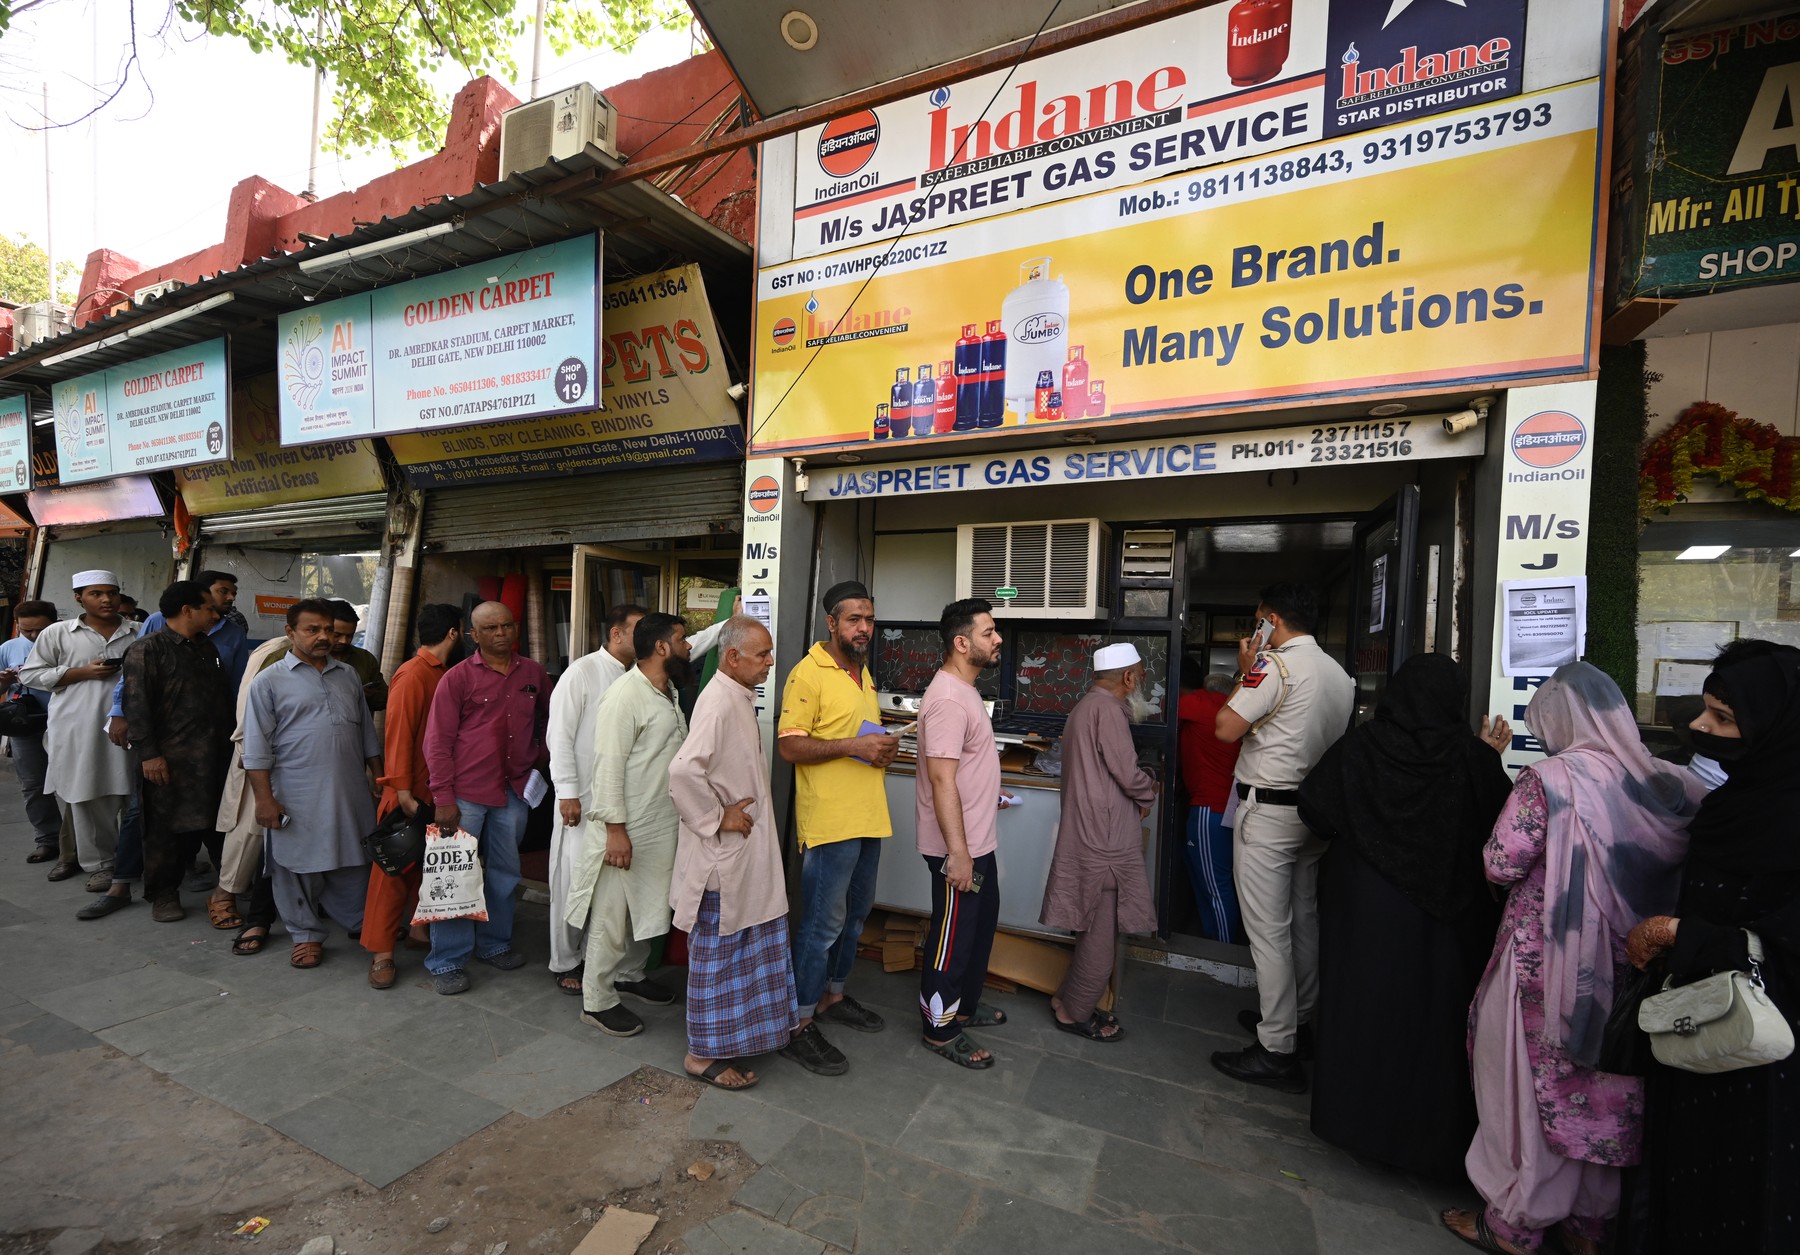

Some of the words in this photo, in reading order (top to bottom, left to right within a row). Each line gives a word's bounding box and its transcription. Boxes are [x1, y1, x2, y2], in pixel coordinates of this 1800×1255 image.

[1231, 20, 1289, 48] Indane
[1663, 27, 1737, 65] GST
[1339, 36, 1512, 99] Indane
[1340, 62, 1502, 108] SAFE.RELIABLE.CONVENIENT
[1337, 107, 1381, 127] STAR
[1385, 77, 1508, 117] DISTRIBUTOR
[925, 66, 1187, 173] Indane
[820, 127, 877, 156] इंडियनऑयल
[925, 112, 1171, 186] SAFE.RELIABLE.CONVENIENT
[1118, 190, 1180, 217] Mob.:
[1187, 149, 1354, 203] 9811138843,
[1362, 102, 1553, 166] 9319753793
[815, 171, 880, 201] IndianOil
[819, 215, 863, 246] M/s
[871, 171, 1032, 233] JASPREET
[1043, 150, 1116, 192] GAS
[1128, 102, 1309, 171] SERVICE
[1649, 194, 1713, 236] Mfr:
[1721, 184, 1766, 224] All
[1124, 263, 1214, 305] One
[1230, 221, 1401, 288] Brand.
[1698, 242, 1798, 281] SHOP
[771, 274, 795, 291] GST
[797, 269, 815, 285] NO
[403, 291, 475, 327] GOLDEN
[479, 271, 556, 311] CARPET
[331, 321, 352, 353] AI
[388, 348, 402, 360] DR.
[403, 339, 449, 357] AMBEDKAR
[450, 330, 493, 349] STADIUM,
[494, 323, 531, 340] CARPET
[532, 313, 577, 331] MARKET,
[807, 306, 912, 340] Indane
[1121, 323, 1244, 368] Many
[1259, 282, 1544, 349] Solutions.
[331, 350, 365, 368] IMPACT
[411, 353, 437, 369] DELHI
[437, 350, 463, 366] GATE,
[464, 346, 485, 360] NEW
[486, 339, 516, 356] DELHI
[517, 334, 547, 351] 110002
[771, 345, 797, 355] IndianOil
[123, 372, 163, 398] GOLDEN
[164, 362, 205, 389] CARPET
[331, 364, 368, 382] SUMMIT
[560, 363, 582, 374] SHOP
[565, 373, 577, 382] NO
[406, 388, 432, 401] Phone
[433, 385, 448, 397] No.
[449, 377, 500, 395] 9650411306,
[500, 367, 553, 387] 9818333417
[562, 383, 582, 400] 19
[84, 392, 97, 416] AI
[124, 406, 150, 420] AMBEDKAR
[173, 397, 193, 410] CARPET
[612, 388, 671, 410] VINYLS
[84, 413, 104, 427] IMPACT
[129, 417, 144, 428] DELHI
[144, 415, 158, 426] GATE,
[158, 413, 169, 423] NEW
[169, 409, 185, 421] DELHI
[419, 407, 437, 420] GST
[85, 423, 106, 437] SUMMIT
[441, 436, 489, 454] BLINDS,
[489, 433, 515, 449] DRY
[517, 422, 591, 445] CLEANING,
[591, 413, 654, 436] BINDING
[1310, 420, 1412, 445] 23711157
[1515, 431, 1582, 448] इंडियनऑयल
[127, 441, 142, 451] Phone
[142, 439, 151, 448] No.
[210, 440, 221, 452] 20
[407, 465, 430, 476] Shop
[431, 463, 446, 473] No.
[461, 459, 474, 469] Dr.
[474, 455, 520, 468] Ambedkar
[521, 449, 562, 464] Stadium
[563, 445, 591, 459] Delhi
[593, 440, 623, 454] Gate,
[623, 437, 649, 450] New
[649, 428, 727, 448] Delhi-110002
[1310, 439, 1413, 463] 23321516
[135, 456, 145, 466] GST
[182, 461, 230, 483] Carpets,
[231, 456, 255, 474] Non
[255, 448, 299, 469] Woven
[300, 439, 358, 464] Carpets
[434, 472, 447, 482] Ph.
[522, 463, 550, 473] E-mail
[555, 445, 697, 472] goldencarpets19@gmail.com
[828, 462, 971, 498] JASPREET
[983, 456, 1051, 486] GAS
[1063, 442, 1217, 480] SERVICE
[17, 474, 25, 484] 21
[224, 472, 281, 498] Artificial
[281, 469, 320, 488] Grass
[1508, 468, 1586, 484] IndianOil
[746, 513, 780, 523] IndianOil
[1505, 513, 1581, 541] M/s
[746, 542, 778, 560] M/s
[448, 863, 474, 872] WEARS
